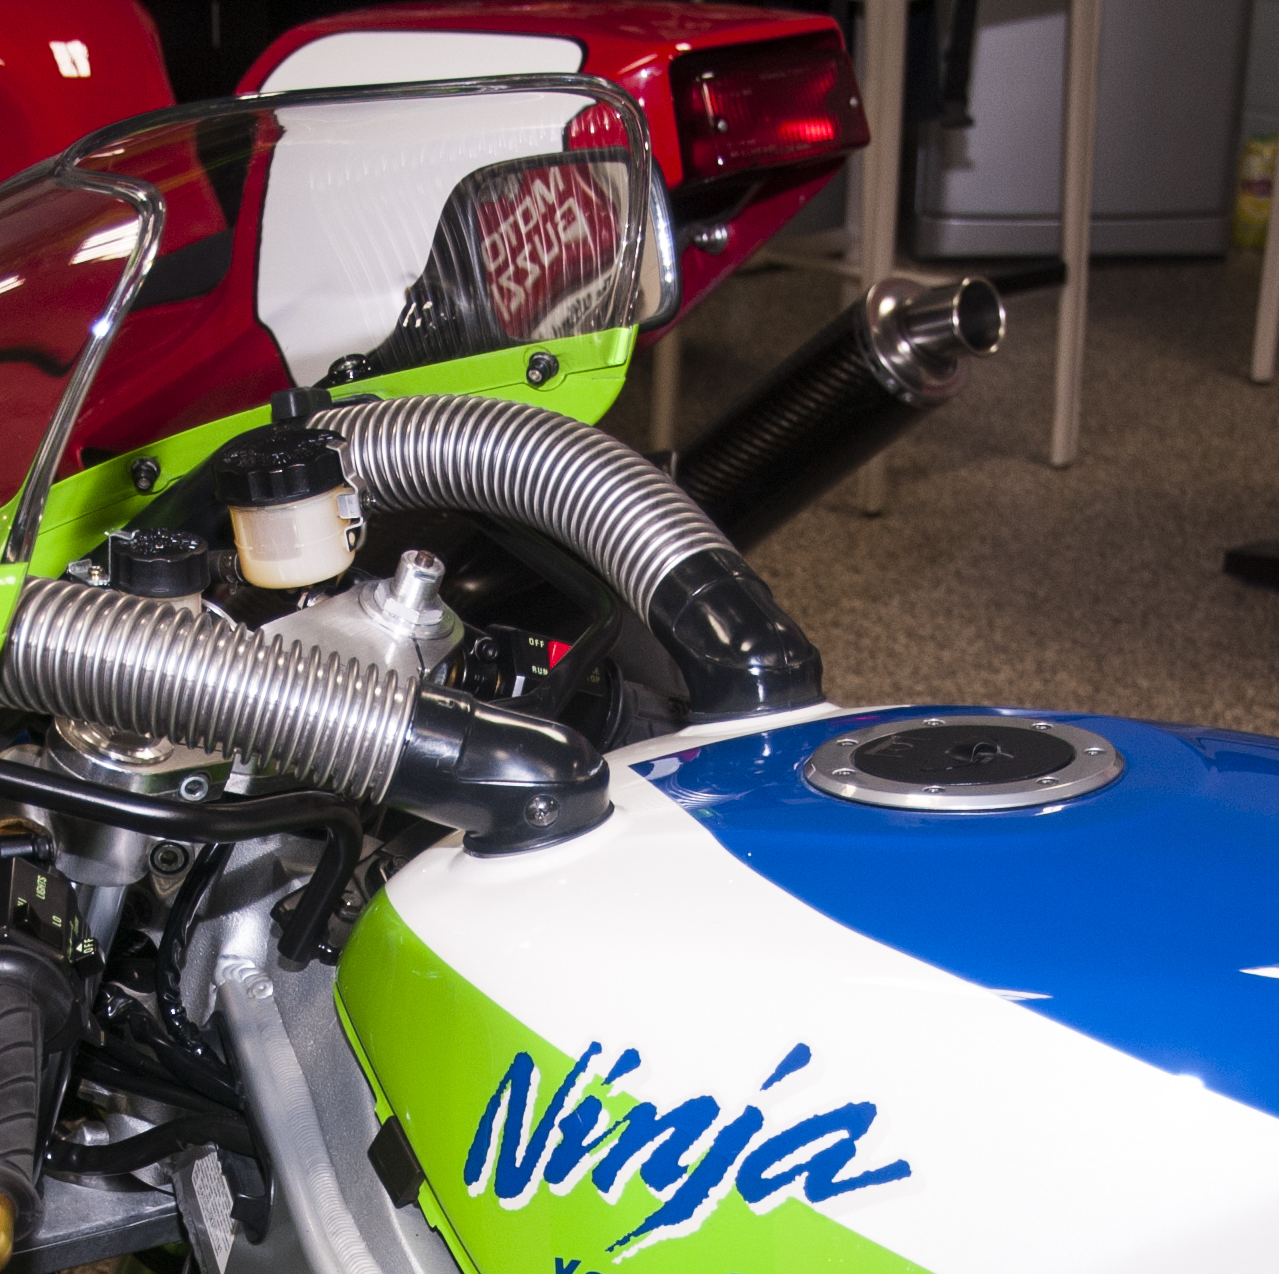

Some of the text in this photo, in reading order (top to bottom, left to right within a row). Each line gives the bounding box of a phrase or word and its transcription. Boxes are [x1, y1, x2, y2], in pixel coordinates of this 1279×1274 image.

[528, 637, 545, 649] OFF
[531, 665, 549, 676] RUN
[35, 874, 48, 900] LIGHTS
[463, 1041, 912, 1255] Ninja
